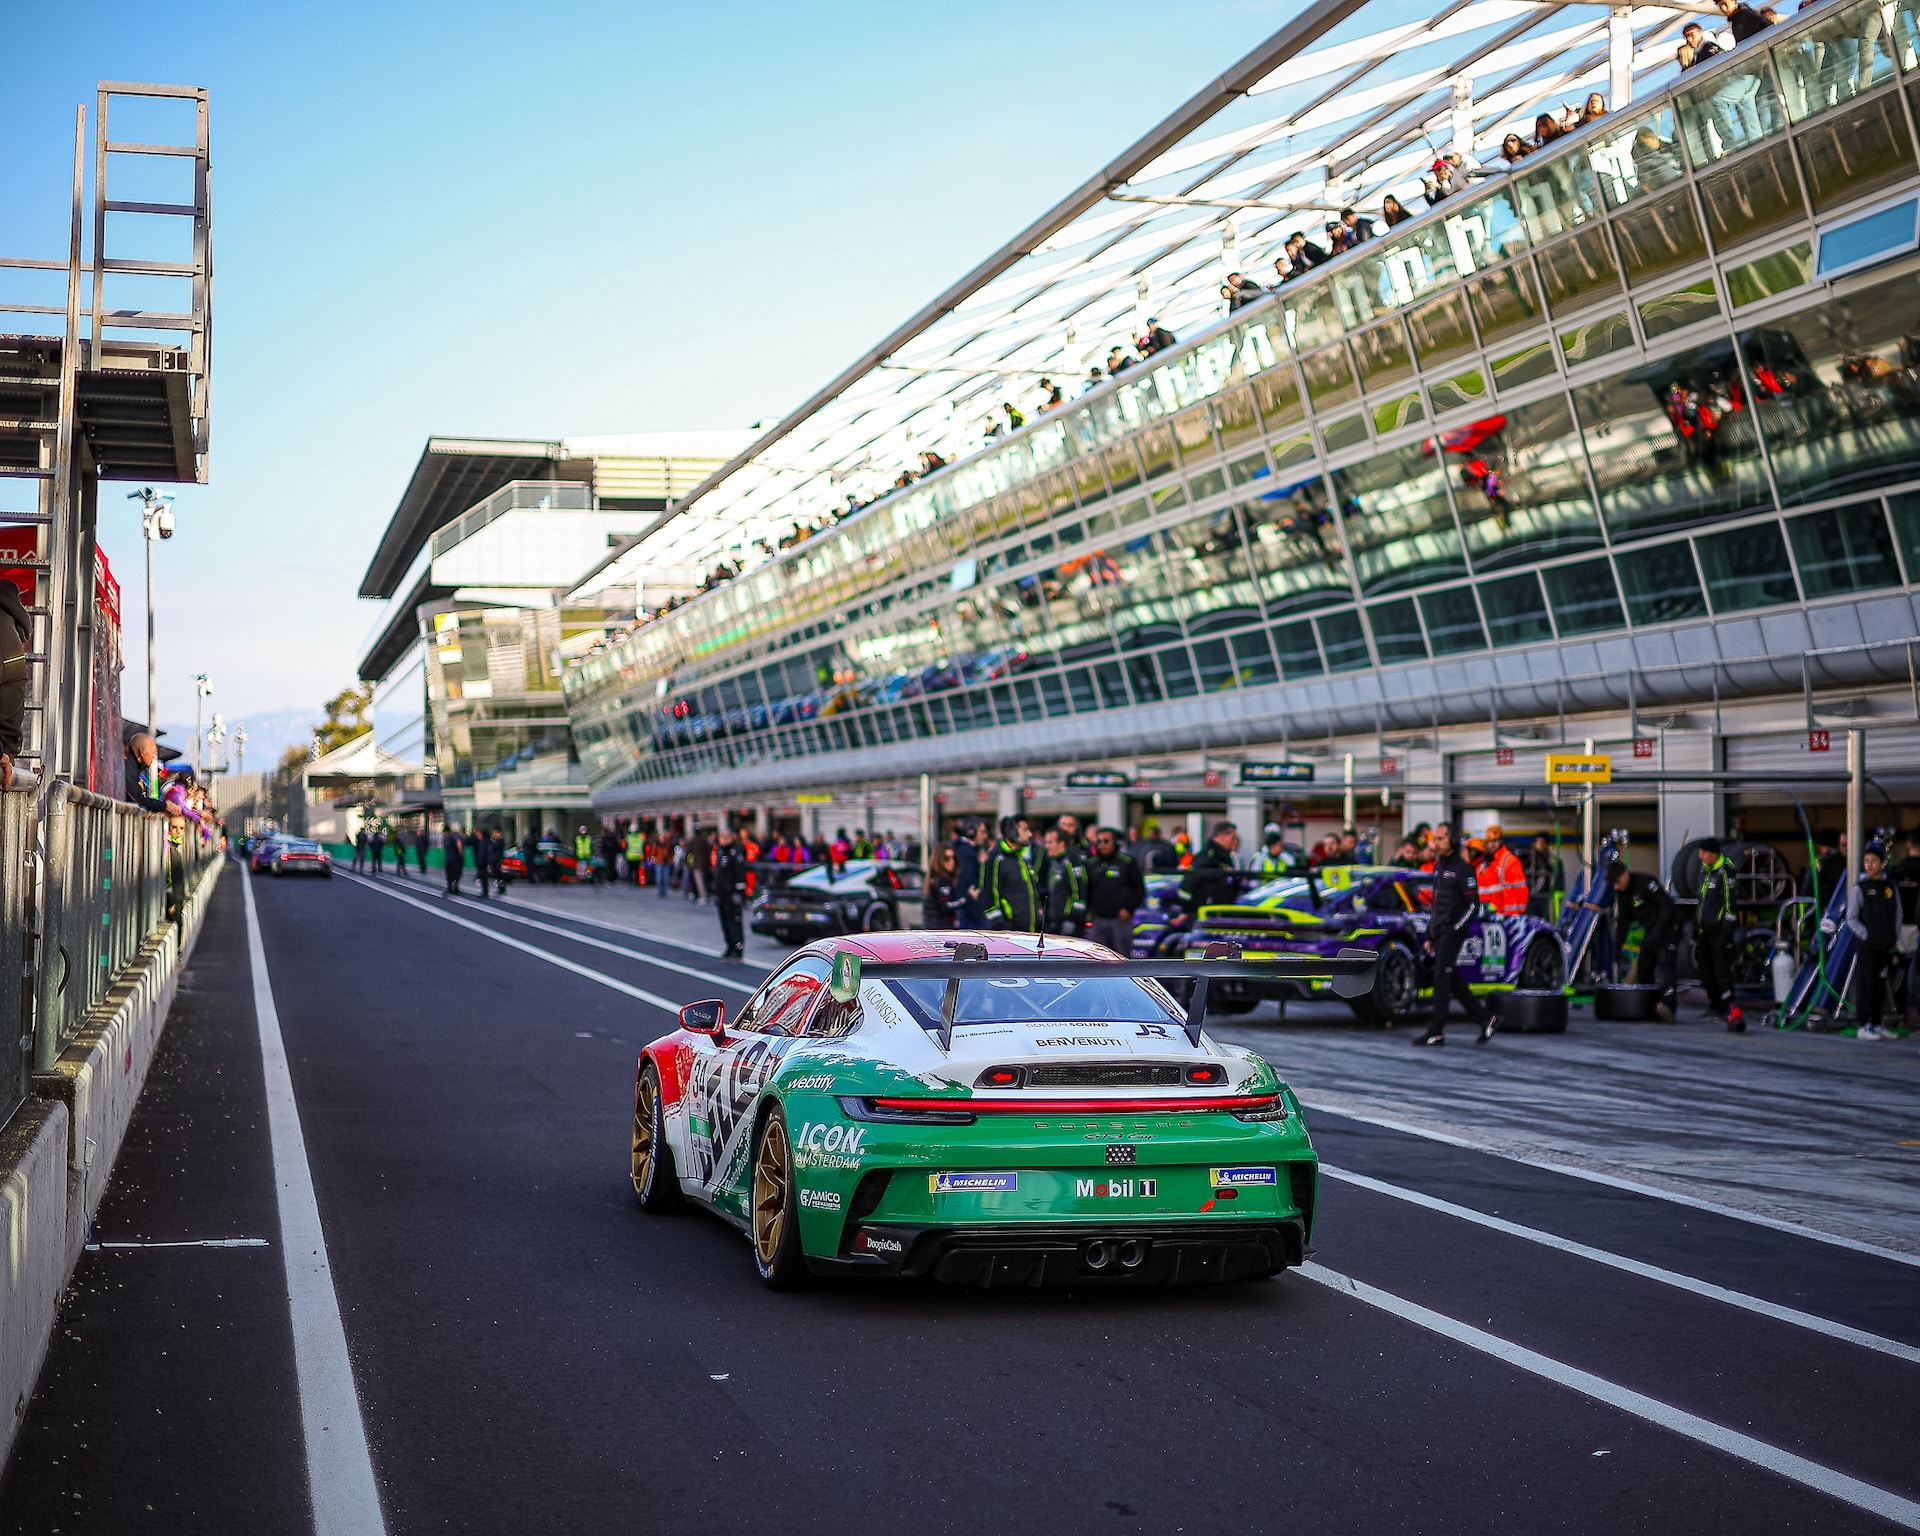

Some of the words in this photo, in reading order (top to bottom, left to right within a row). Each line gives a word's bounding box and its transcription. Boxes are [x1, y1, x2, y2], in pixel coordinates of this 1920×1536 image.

[863, 986, 902, 1029] ALCANSIDE
[1036, 1037, 1122, 1047] BENVENUTI
[692, 1059, 709, 1100] 34
[1033, 1121, 1194, 1130] PORSCHE
[798, 1122, 866, 1155] ICON.
[1083, 1132, 1124, 1140] GT3
[795, 1152, 861, 1170] AMSTERDAM
[953, 1178, 1007, 1187] MICHELIN
[1232, 1172, 1272, 1181] MICHELIN
[1076, 1179, 1134, 1198] Mobil
[1140, 1179, 1156, 1198] 1
